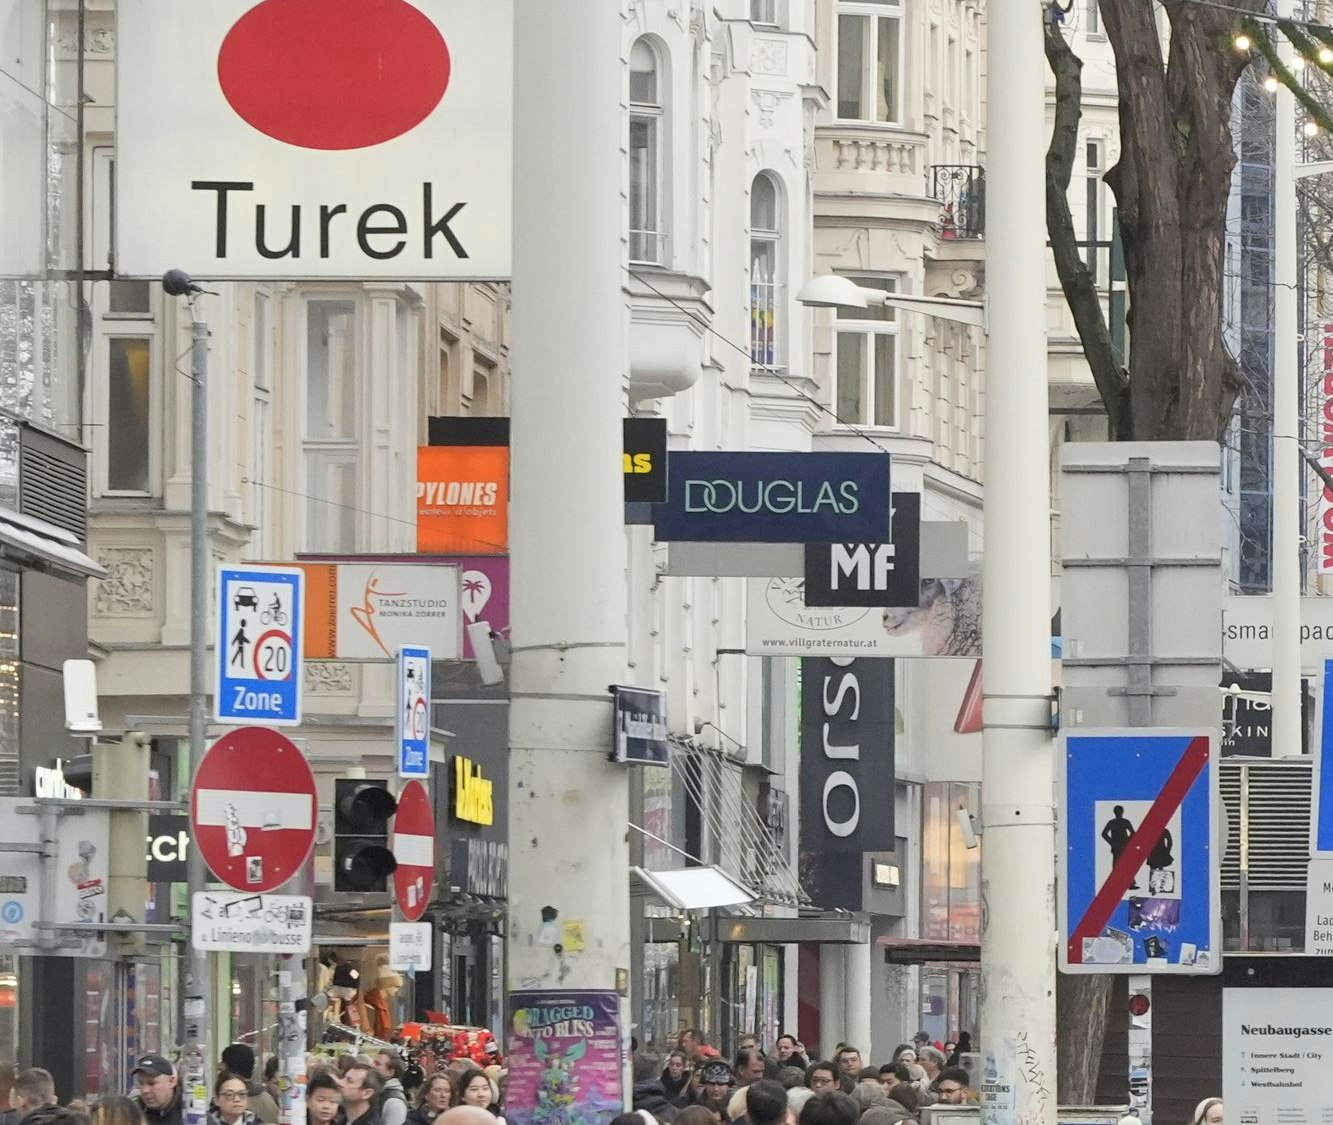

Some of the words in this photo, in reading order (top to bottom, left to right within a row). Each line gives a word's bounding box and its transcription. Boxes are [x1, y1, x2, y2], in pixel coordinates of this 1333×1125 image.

[191, 181, 470, 260] Turek
[416, 482, 497, 505] PYLONES
[685, 479, 860, 515] DOUGLAS
[379, 599, 447, 608] TANZSTUDIO
[796, 613, 843, 628] NATUR
[762, 637, 878, 649] www.villgraternatur.at
[264, 646, 286, 672] 20
[233, 686, 283, 711] Zone
[822, 656, 861, 838] ors
[555, 1020, 595, 1038] BLISS
[1241, 1024, 1333, 1038] Neubaugasse
[1307, 1052, 1322, 1060] City
[1251, 1066, 1295, 1074] Spittelberg
